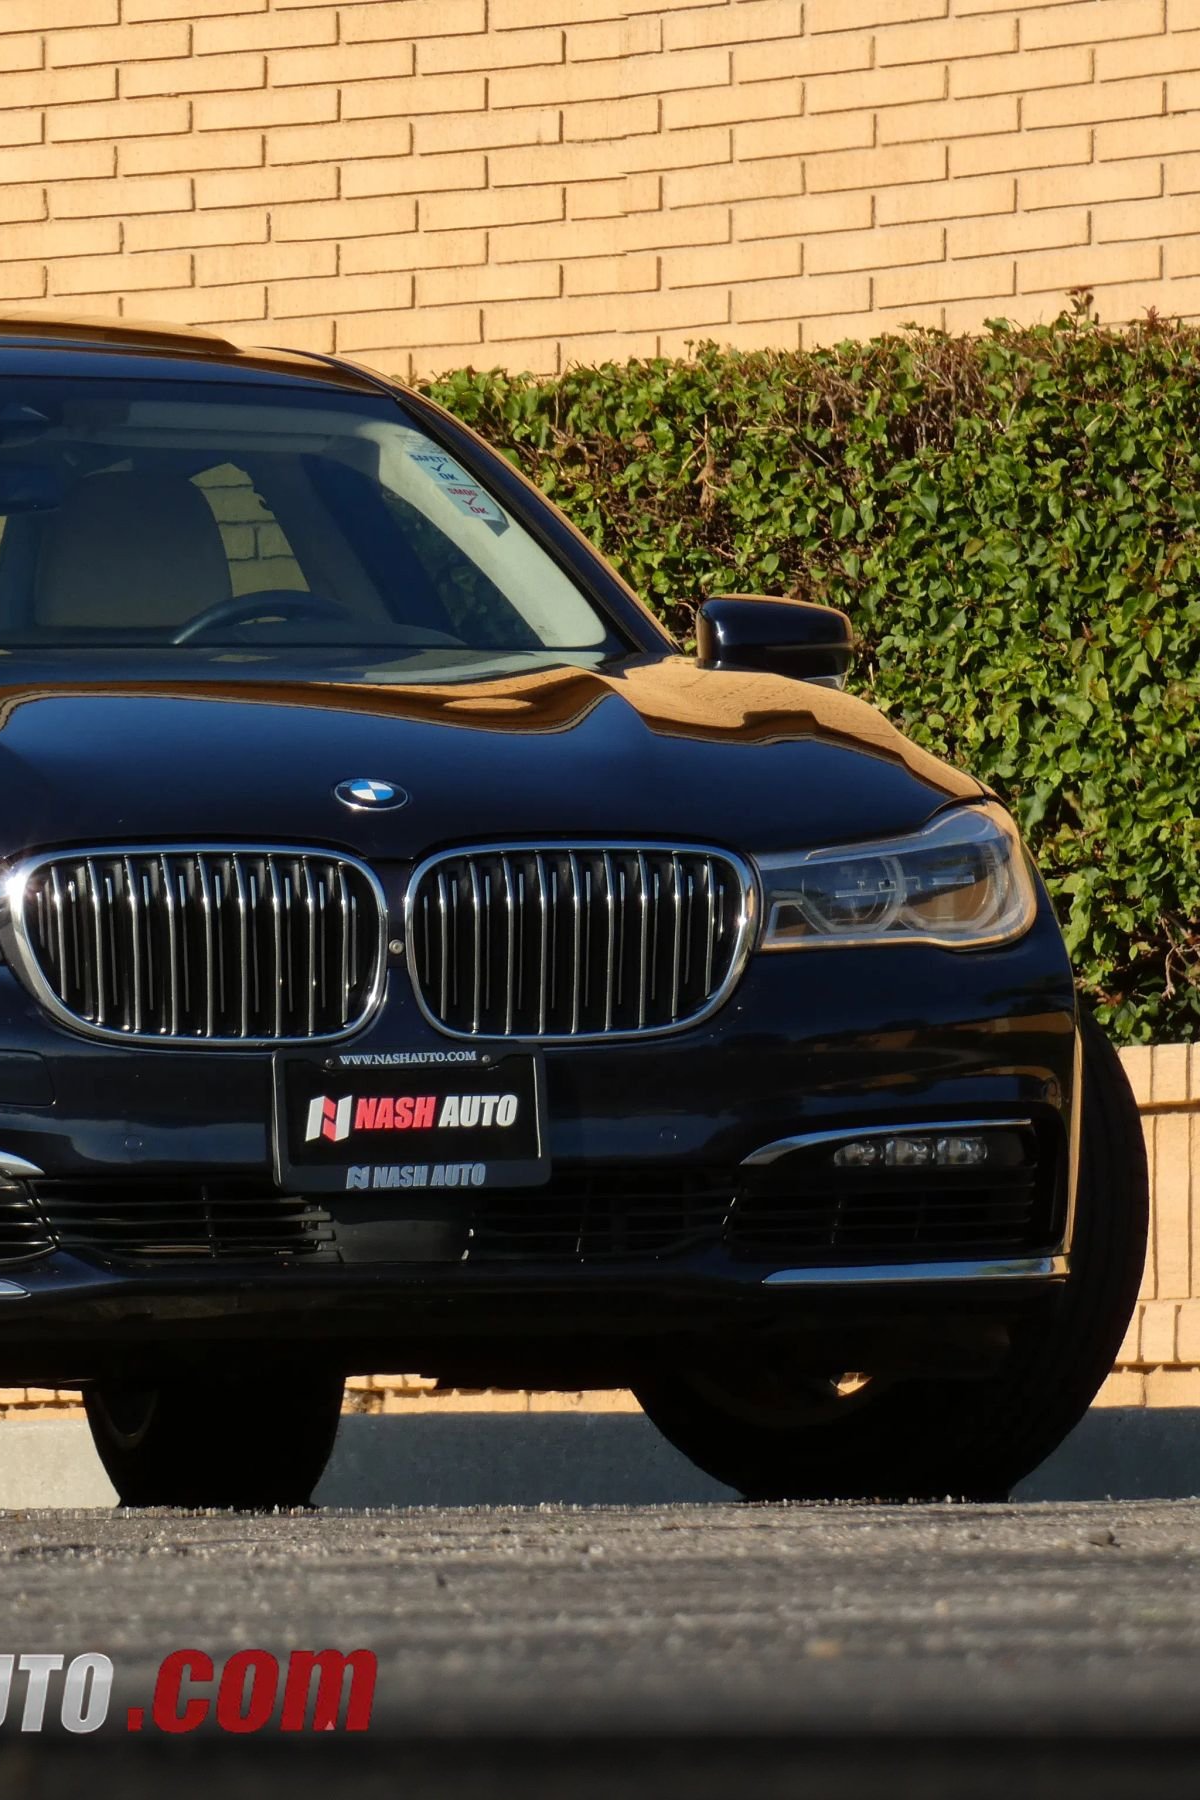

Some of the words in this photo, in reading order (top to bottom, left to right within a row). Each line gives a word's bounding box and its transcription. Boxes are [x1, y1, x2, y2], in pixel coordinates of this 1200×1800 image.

[409, 453, 449, 464] SAFETY
[438, 472, 459, 481] OK
[470, 506, 490, 515] OK
[339, 1050, 477, 1065] WWW.NASHAUTO.COM
[354, 1096, 437, 1129] NASH
[438, 1094, 518, 1128] AUTO
[372, 1165, 429, 1188] NASH
[430, 1163, 486, 1187] AUTO
